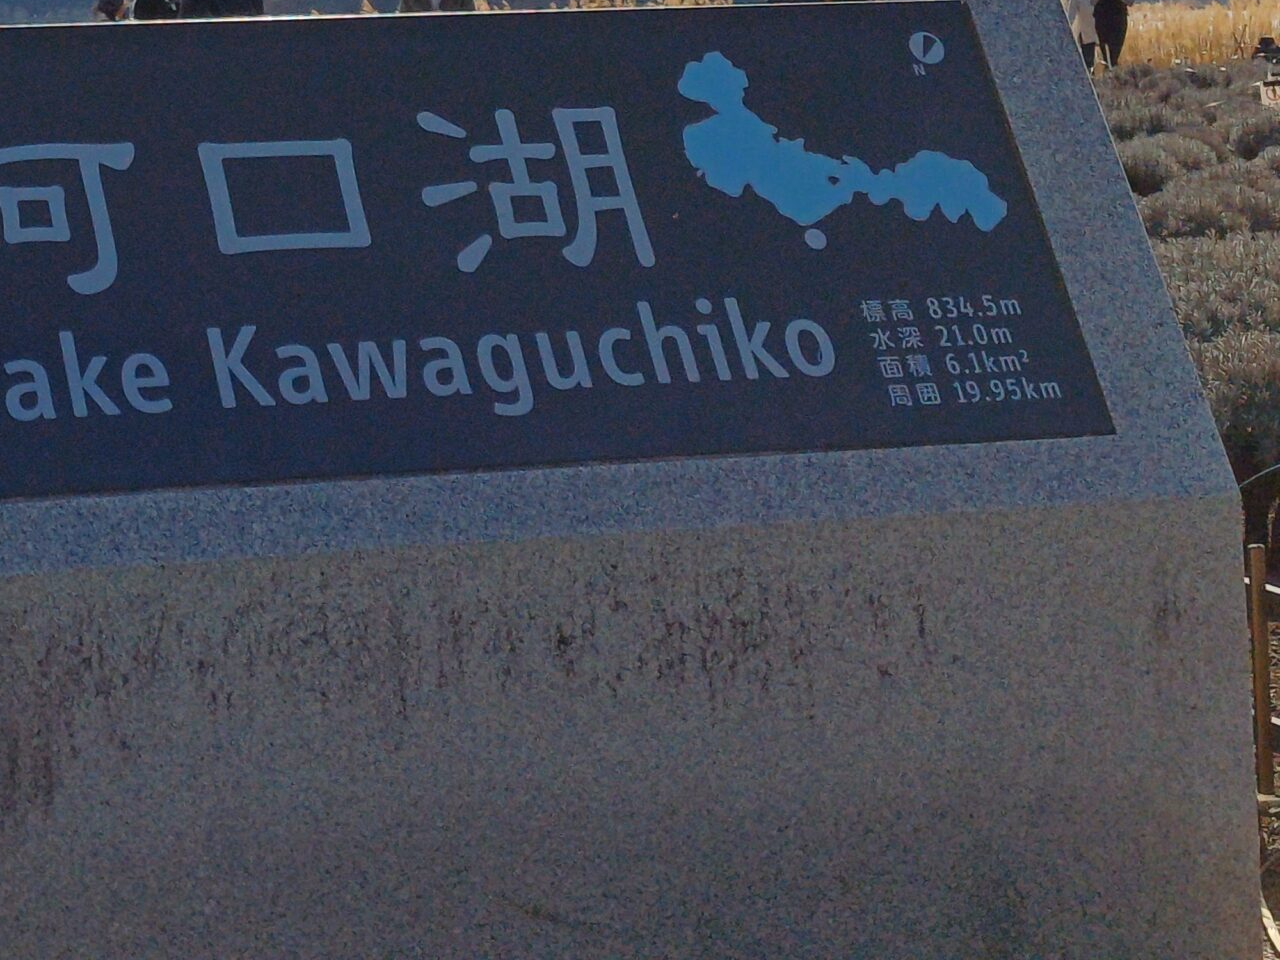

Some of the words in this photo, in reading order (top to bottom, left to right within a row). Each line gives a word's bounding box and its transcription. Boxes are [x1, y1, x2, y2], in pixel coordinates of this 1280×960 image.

[926, 294, 1022, 319] 834.5m
[869, 327, 924, 350] 水深
[934, 324, 1013, 347] 21.0m
[207, 297, 836, 417] Kawaguchiko
[888, 382, 942, 407] 周囲
[953, 377, 1062, 404] 19.95km
